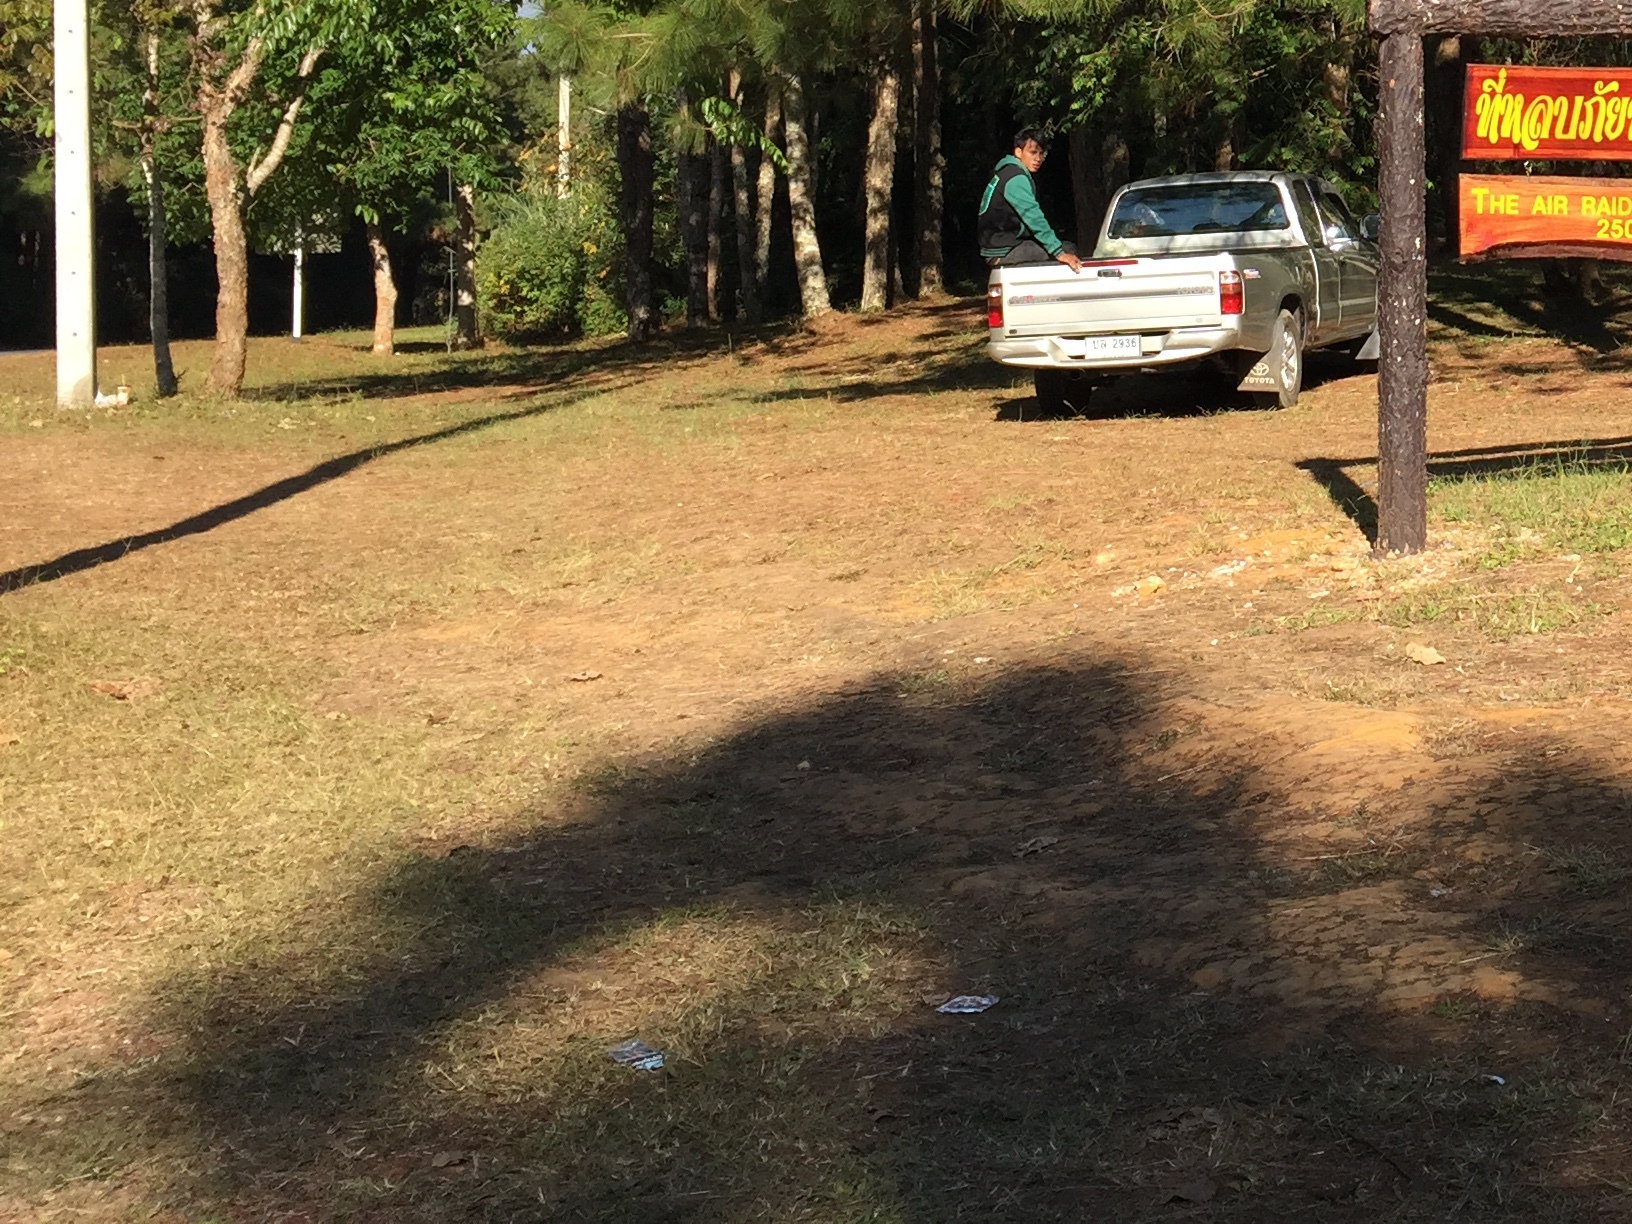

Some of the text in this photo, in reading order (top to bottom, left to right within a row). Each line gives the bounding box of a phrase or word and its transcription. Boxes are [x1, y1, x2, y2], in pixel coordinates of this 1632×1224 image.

[1471, 187, 1520, 216] THE
[1531, 194, 1569, 216] AIR
[1581, 195, 1632, 217] RAID
[1244, 376, 1275, 384] TOYOTA
